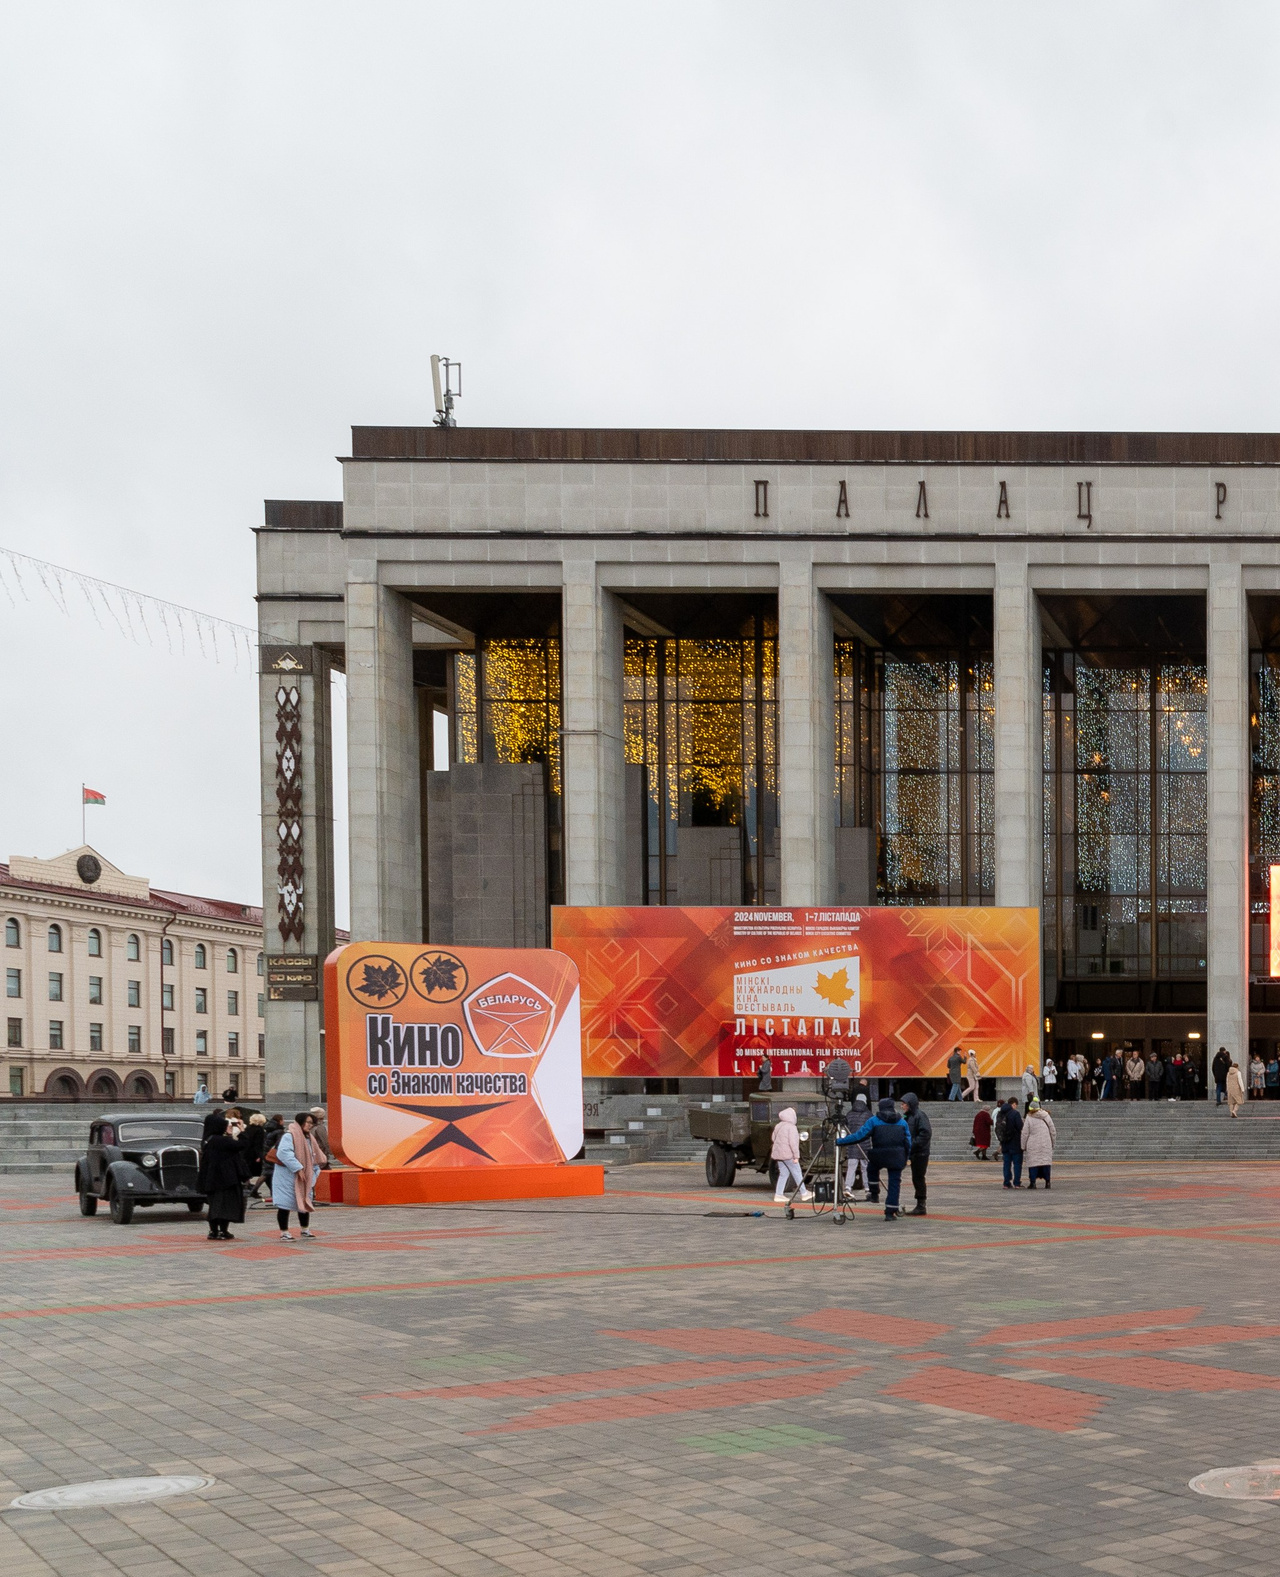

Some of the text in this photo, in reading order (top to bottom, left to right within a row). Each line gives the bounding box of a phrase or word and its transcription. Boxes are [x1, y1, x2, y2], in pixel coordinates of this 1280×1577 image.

[753, 479, 1093, 529] ПАЛАЦ
[734, 912, 794, 922] 2024 NOVEMBER,
[819, 912, 861, 922] ЛІСТАПАДА
[734, 943, 859, 969] КИНО СО ЗНАКОМ КАЧЕСТВА
[736, 977, 770, 985] МІНСКІ
[736, 985, 803, 995] МІЖНАРОДНЫ
[477, 994, 543, 1011] БЕЛАРУСЬ
[736, 994, 758, 1003] КІНА
[736, 1003, 796, 1012] ФЕСТЫВАЛЬ
[734, 1018, 861, 1038] ЛІСТАПАД
[366, 1013, 464, 1069] Кино
[735, 1048, 861, 1056] 30 MINSK INTERNATIONAL FILM FESTIVAL
[734, 1060, 862, 1073] LITAPD
[367, 1069, 527, 1097] со Знаком качества
